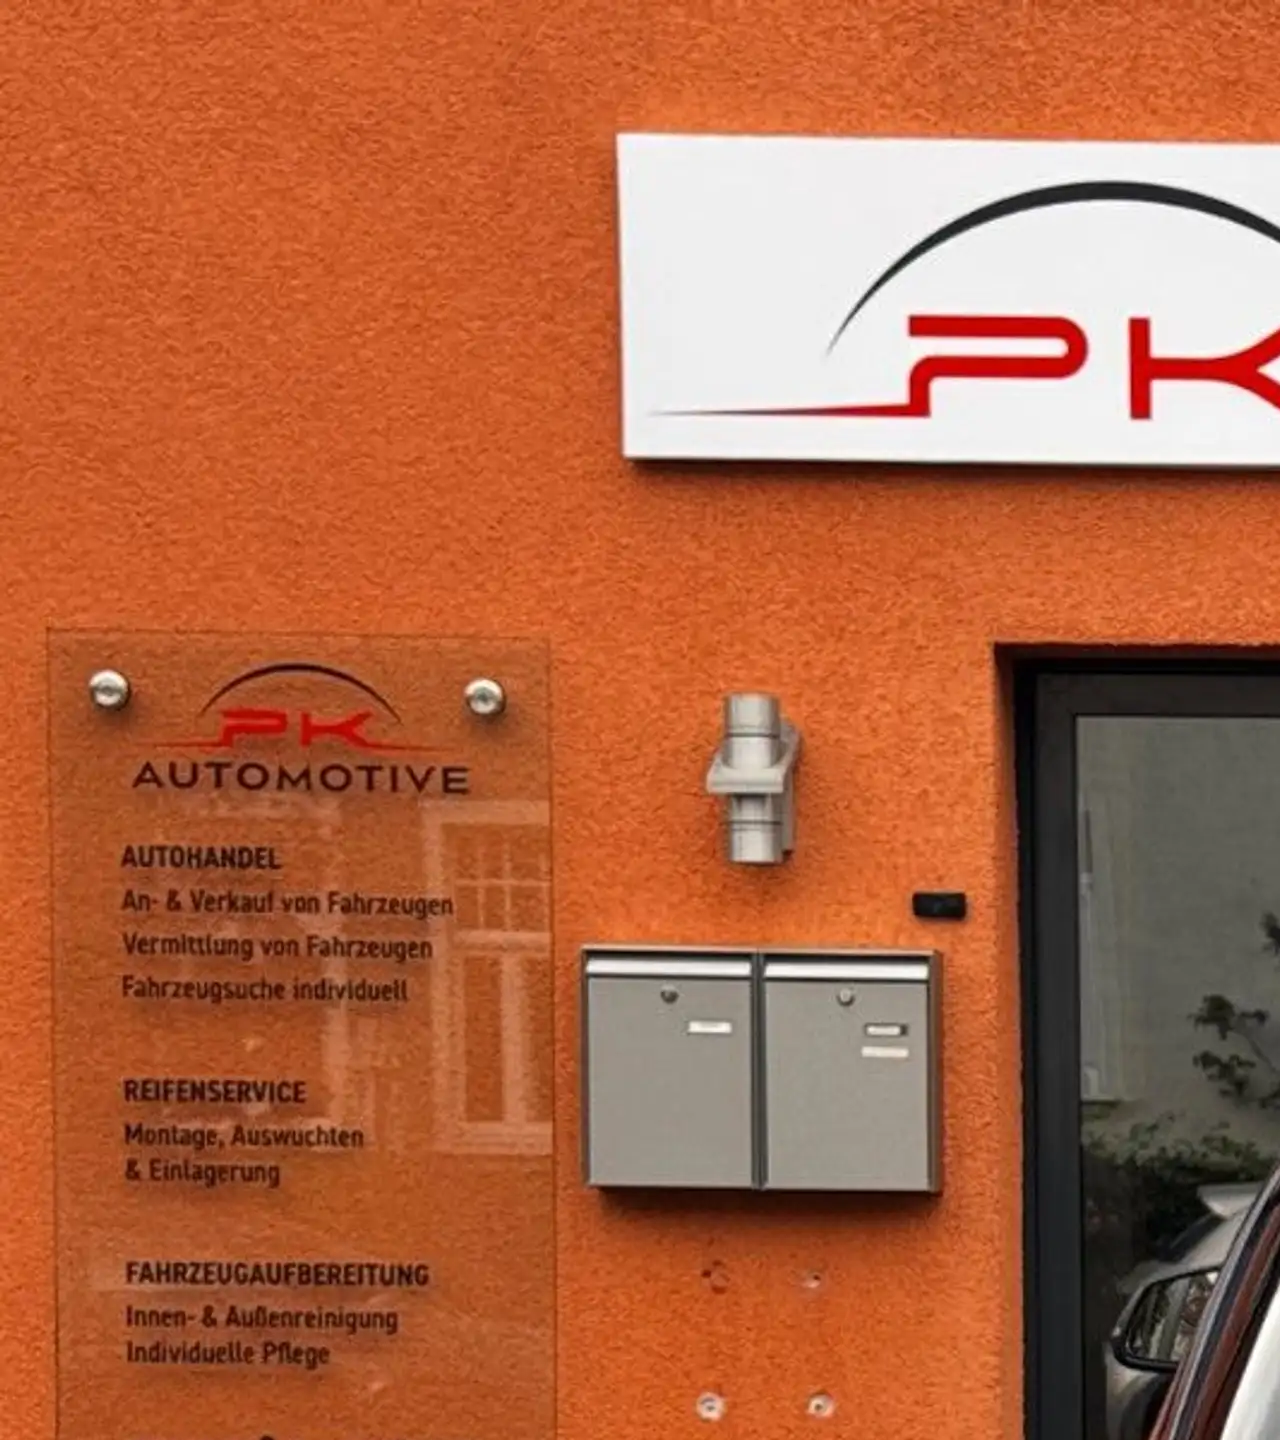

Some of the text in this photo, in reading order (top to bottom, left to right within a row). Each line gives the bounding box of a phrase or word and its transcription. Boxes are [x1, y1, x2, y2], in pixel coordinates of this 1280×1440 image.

[219, 710, 374, 748] PK
[132, 762, 470, 794] AUTOMOTIVE
[121, 846, 282, 869] AUTOHANDEL
[121, 890, 453, 919] An- & Verkauf von Fahrzeugen
[123, 934, 433, 962] Vermittlung von Fahrzeugen
[122, 976, 407, 1003] Fahrzeugsuche individuell
[123, 1080, 307, 1103] REIFENSERVICE
[124, 1124, 364, 1150] Montage, Auswuchten
[125, 1159, 281, 1188] & Einlagerung
[125, 1261, 430, 1286] FAHRZEUGAUFBEREITUNG
[126, 1306, 398, 1335] Innen- & Außenreinigung
[126, 1341, 330, 1370] Individuelle Pflege
